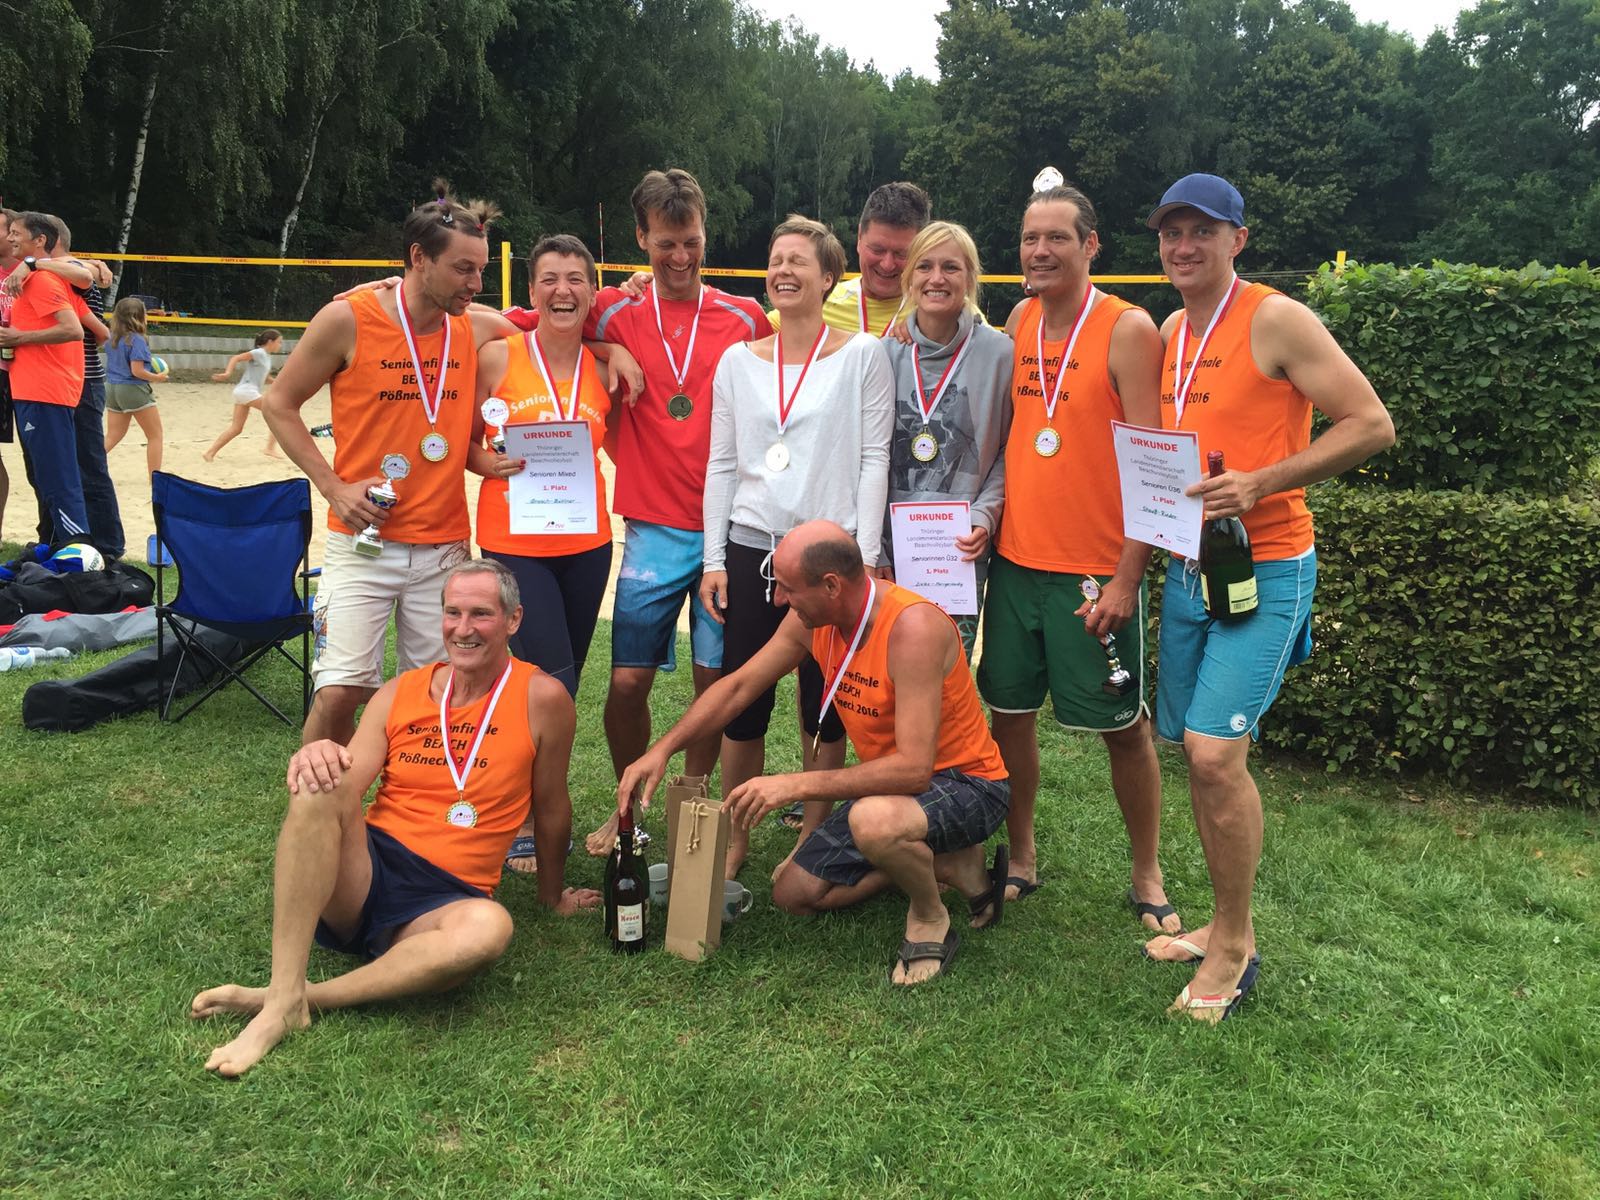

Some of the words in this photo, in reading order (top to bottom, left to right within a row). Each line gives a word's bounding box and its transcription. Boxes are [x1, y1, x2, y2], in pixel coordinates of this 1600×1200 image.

[380, 358, 460, 369] Senionfile
[1029, 371, 1056, 382] BECH
[380, 390, 421, 401] Pößnec
[523, 430, 573, 440] URKUNDE
[1130, 436, 1178, 452] URKUNDE
[1141, 480, 1167, 490] Senioren
[1160, 497, 1176, 506] Platz
[909, 513, 954, 521] URKUNDE
[857, 704, 879, 717] 2016
[458, 757, 488, 768] 216
